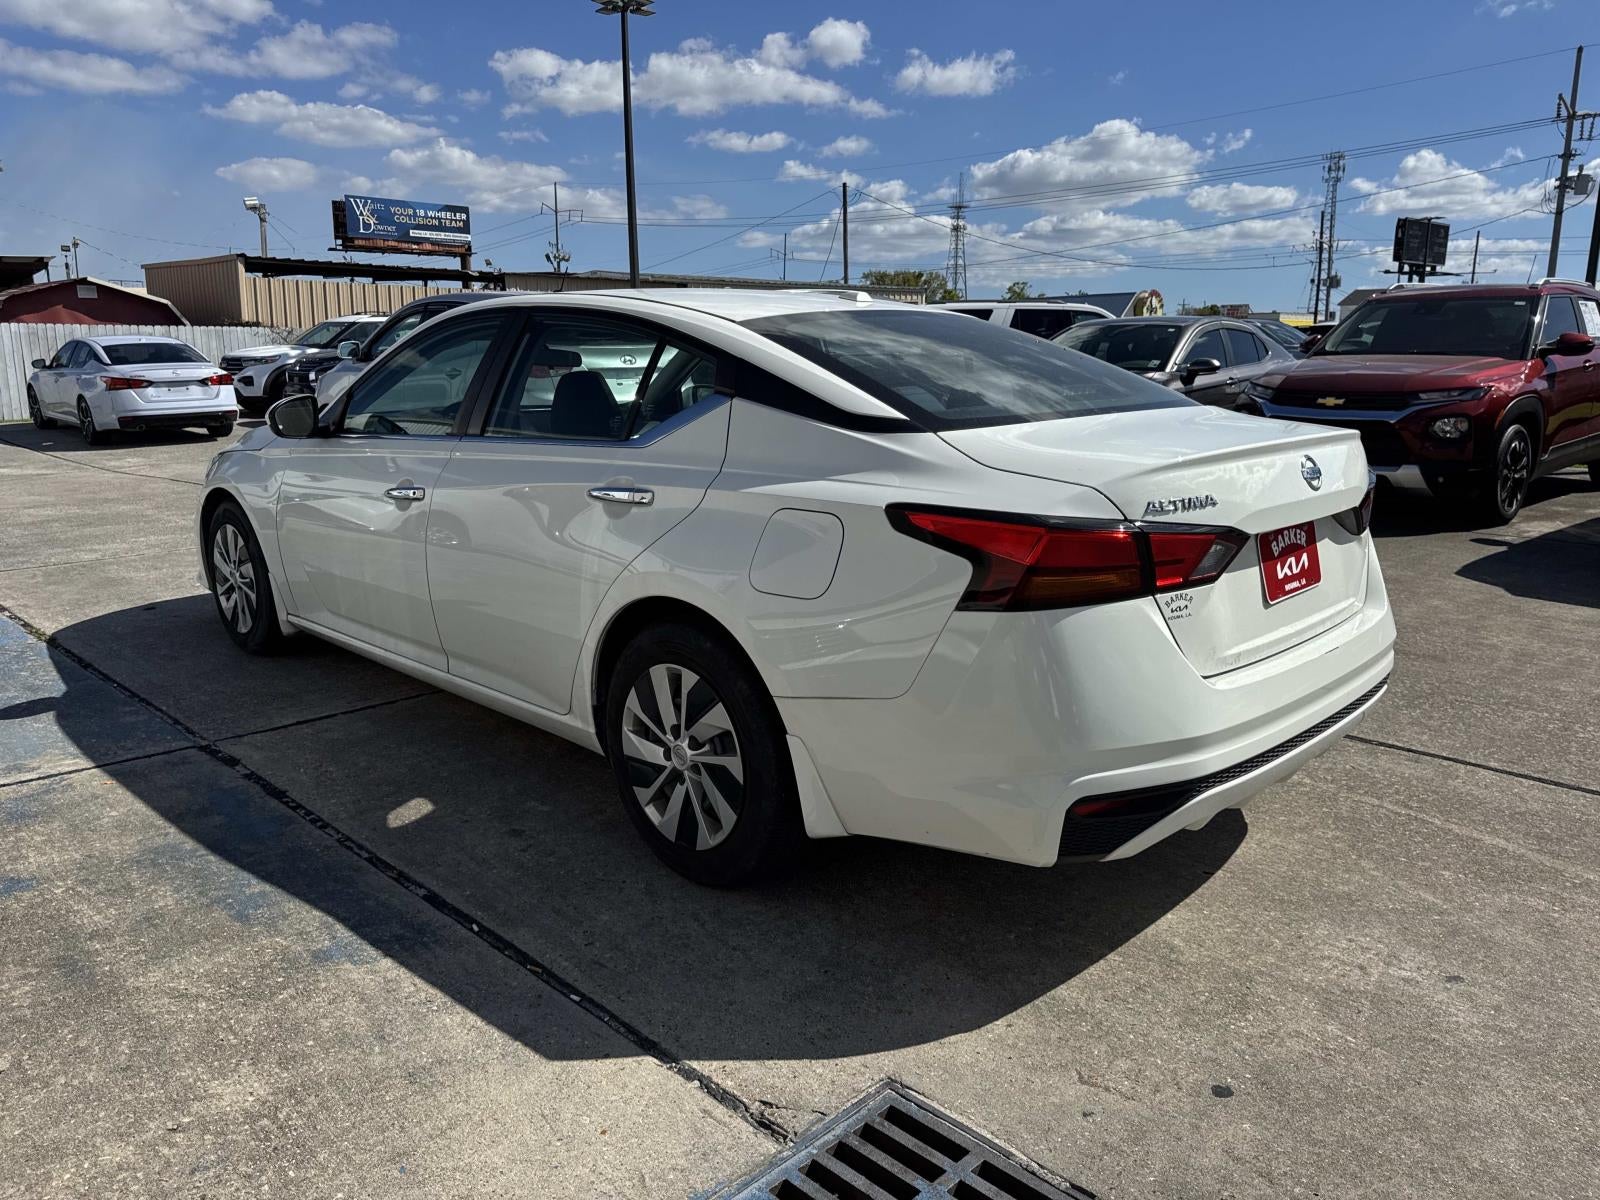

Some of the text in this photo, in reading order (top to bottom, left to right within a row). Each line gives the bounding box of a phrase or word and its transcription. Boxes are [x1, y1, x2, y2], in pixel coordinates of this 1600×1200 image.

[389, 206, 467, 221] YOUR 18 WHEELER
[394, 215, 464, 228] COLLISION TEAM
[1143, 495, 1218, 515] ALTIMA
[1271, 528, 1307, 557] BARKER
[1165, 592, 1193, 608] BARKER
